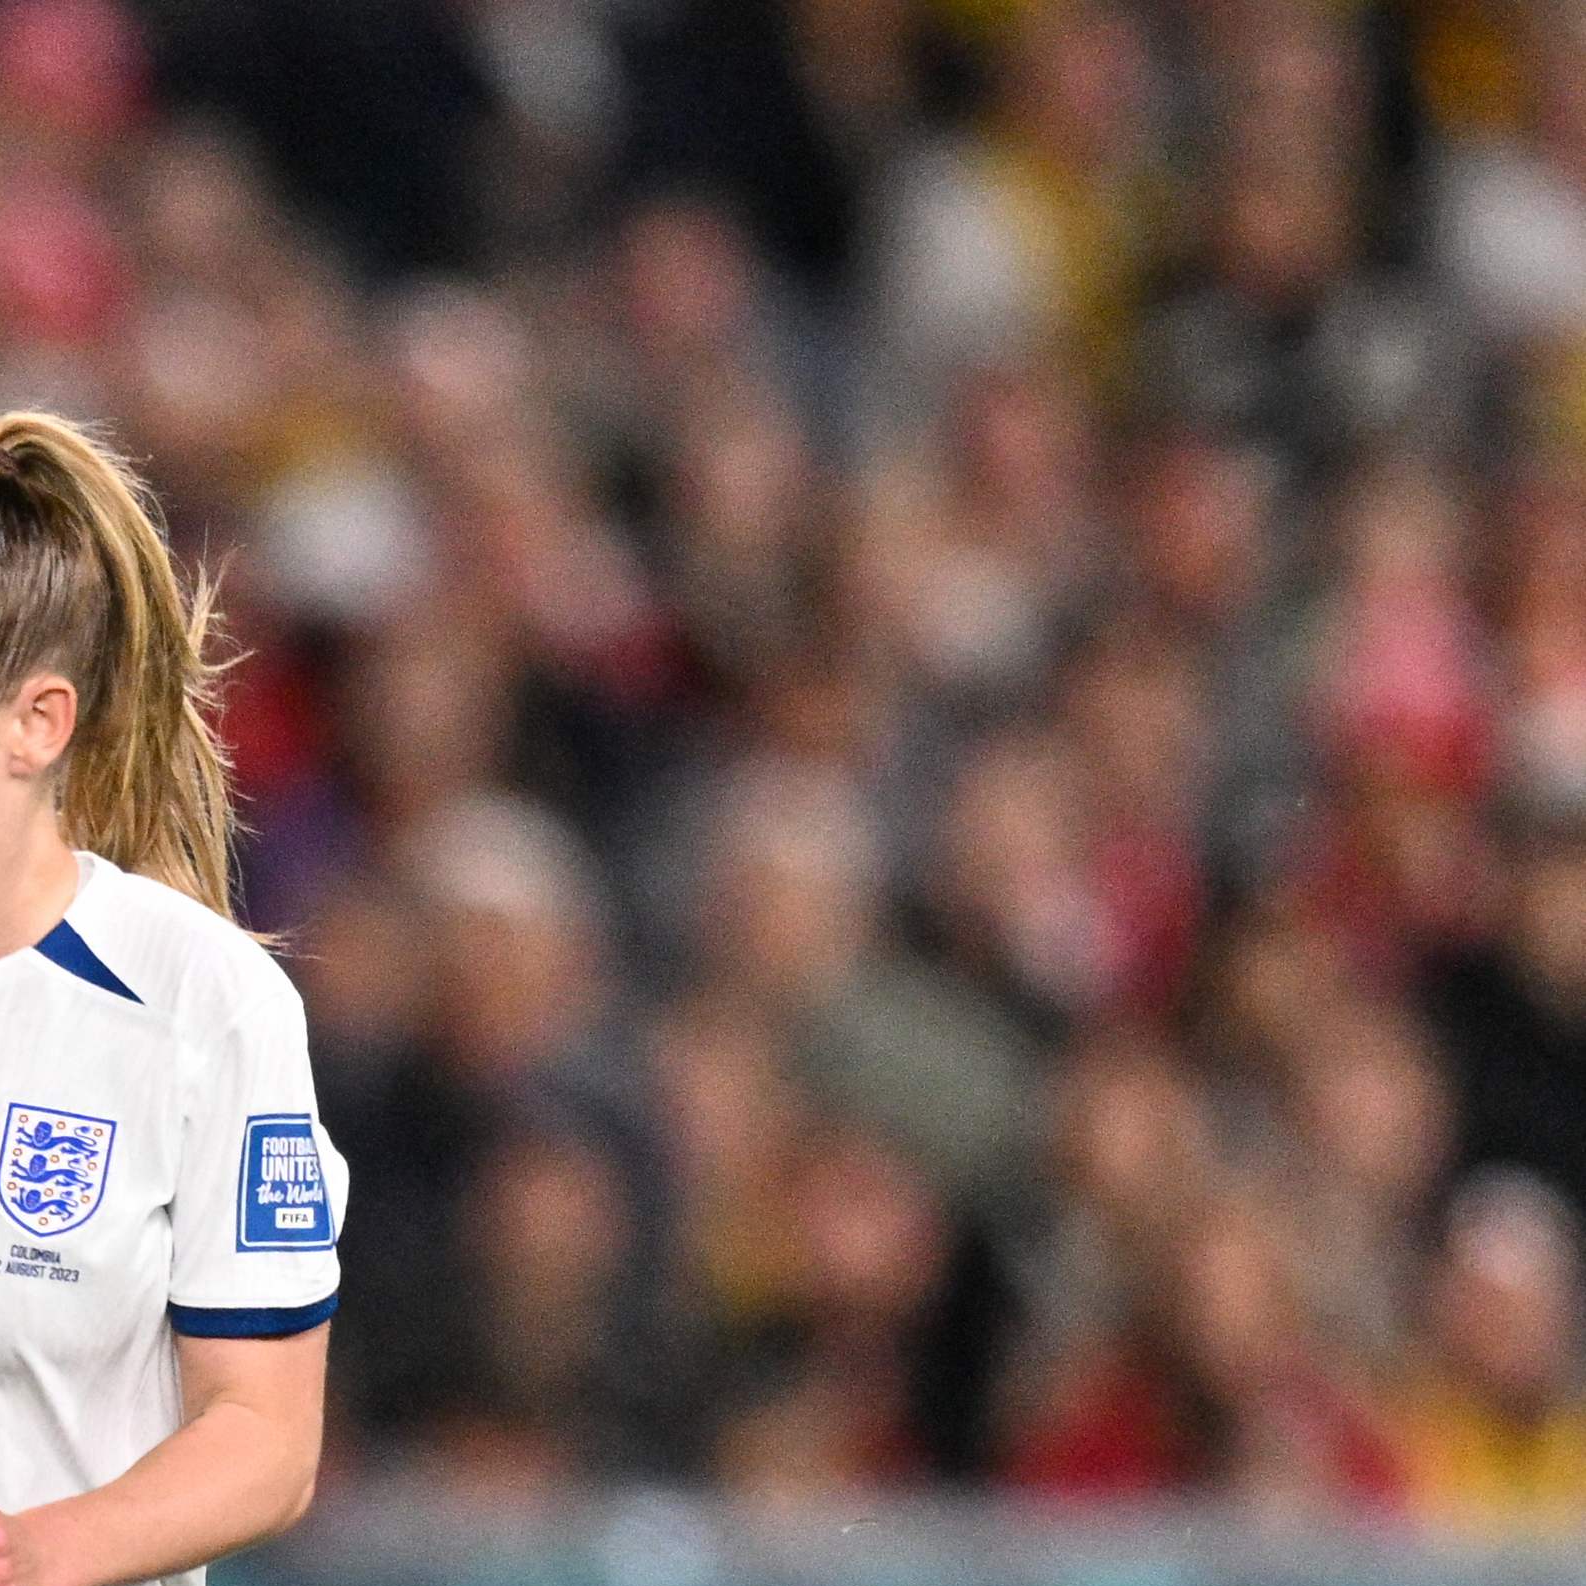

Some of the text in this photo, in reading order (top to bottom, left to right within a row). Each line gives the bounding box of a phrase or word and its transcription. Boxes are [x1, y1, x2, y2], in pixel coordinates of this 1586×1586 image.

[262, 1137, 317, 1156] FOOTBA
[256, 1181, 284, 1205] the
[282, 1213, 308, 1222] FIFA
[10, 1244, 61, 1264] COLOMBIA
[5, 1261, 46, 1278] AUGUST
[49, 1267, 80, 1282] 2023
